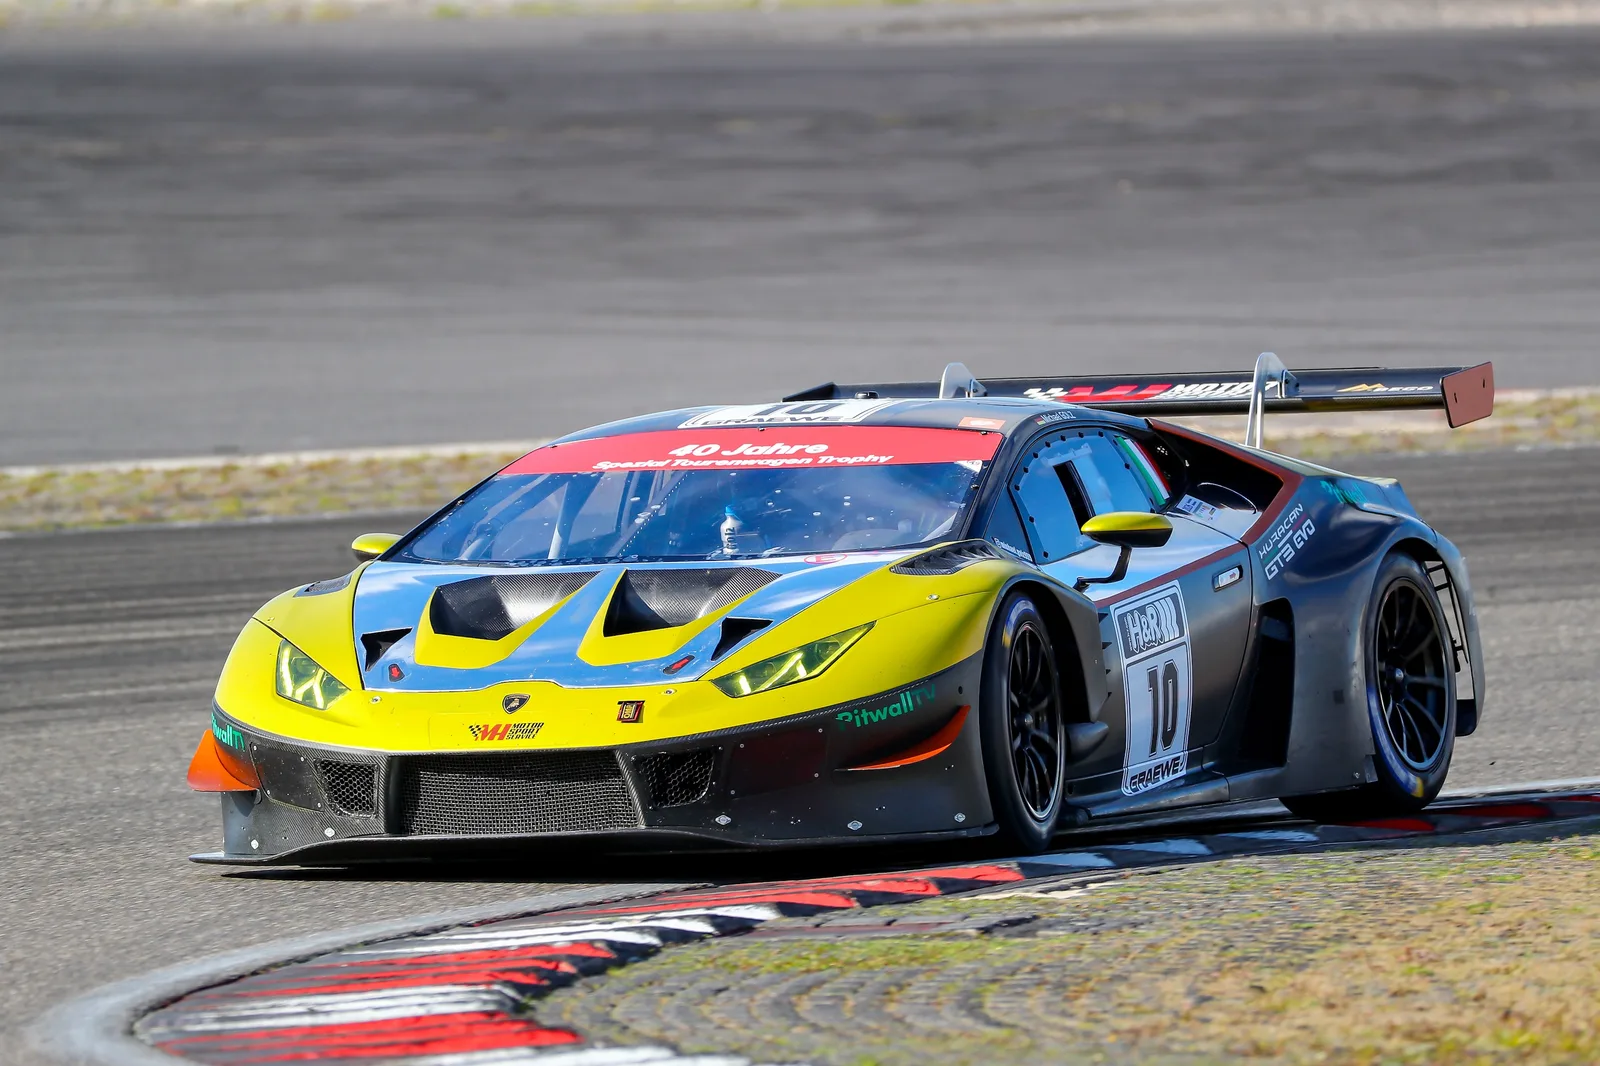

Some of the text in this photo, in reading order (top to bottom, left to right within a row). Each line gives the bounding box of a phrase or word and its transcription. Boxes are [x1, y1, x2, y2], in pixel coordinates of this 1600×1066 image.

[700, 416, 845, 426] GRAEWE
[593, 454, 895, 471] Spezial Tourenwagen Trophy
[668, 443, 829, 457] 40 Jahre
[1259, 503, 1304, 559] HURACAN
[1264, 543, 1296, 580] GT3
[1147, 658, 1179, 757] 10
[511, 722, 545, 730] MOTOR
[1130, 758, 1180, 792] GRAEWE
